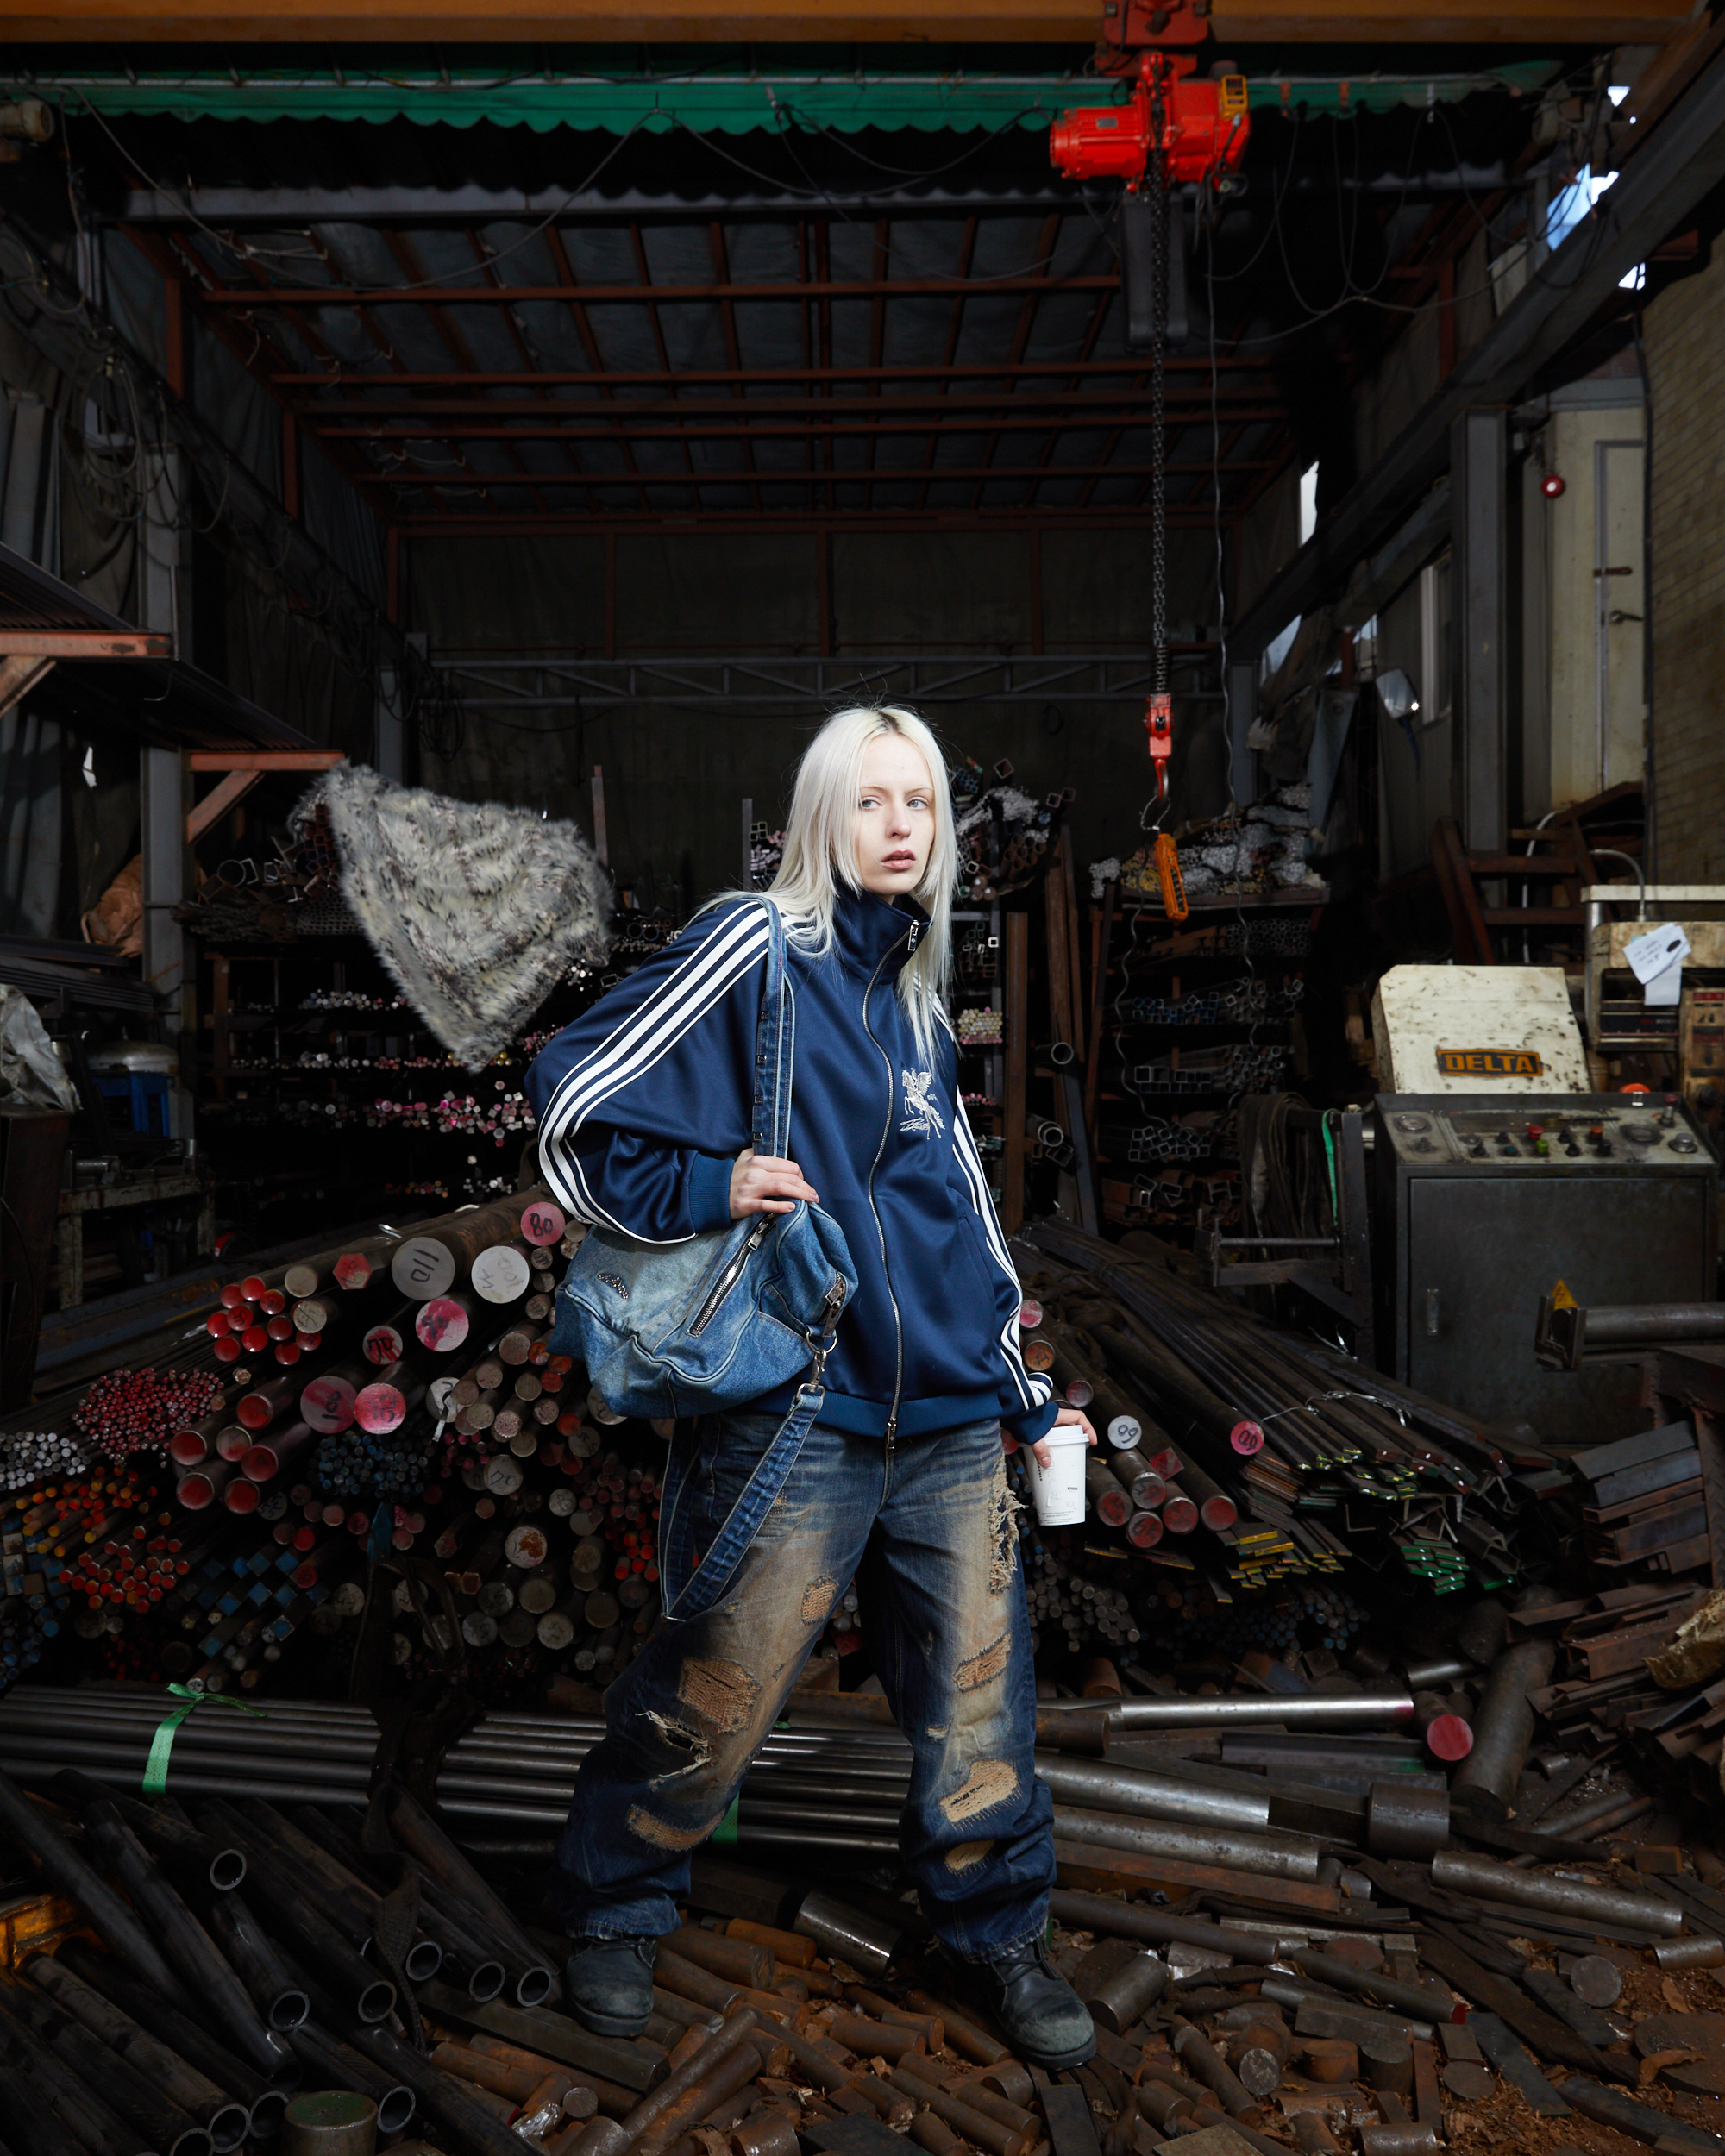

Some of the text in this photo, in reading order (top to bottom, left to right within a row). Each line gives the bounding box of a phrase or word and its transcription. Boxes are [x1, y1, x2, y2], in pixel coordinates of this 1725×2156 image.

[1445, 1054, 1534, 1073] DELTA
[530, 1213, 554, 1237] 80
[421, 1315, 449, 1340] 90
[367, 1334, 394, 1363] 70
